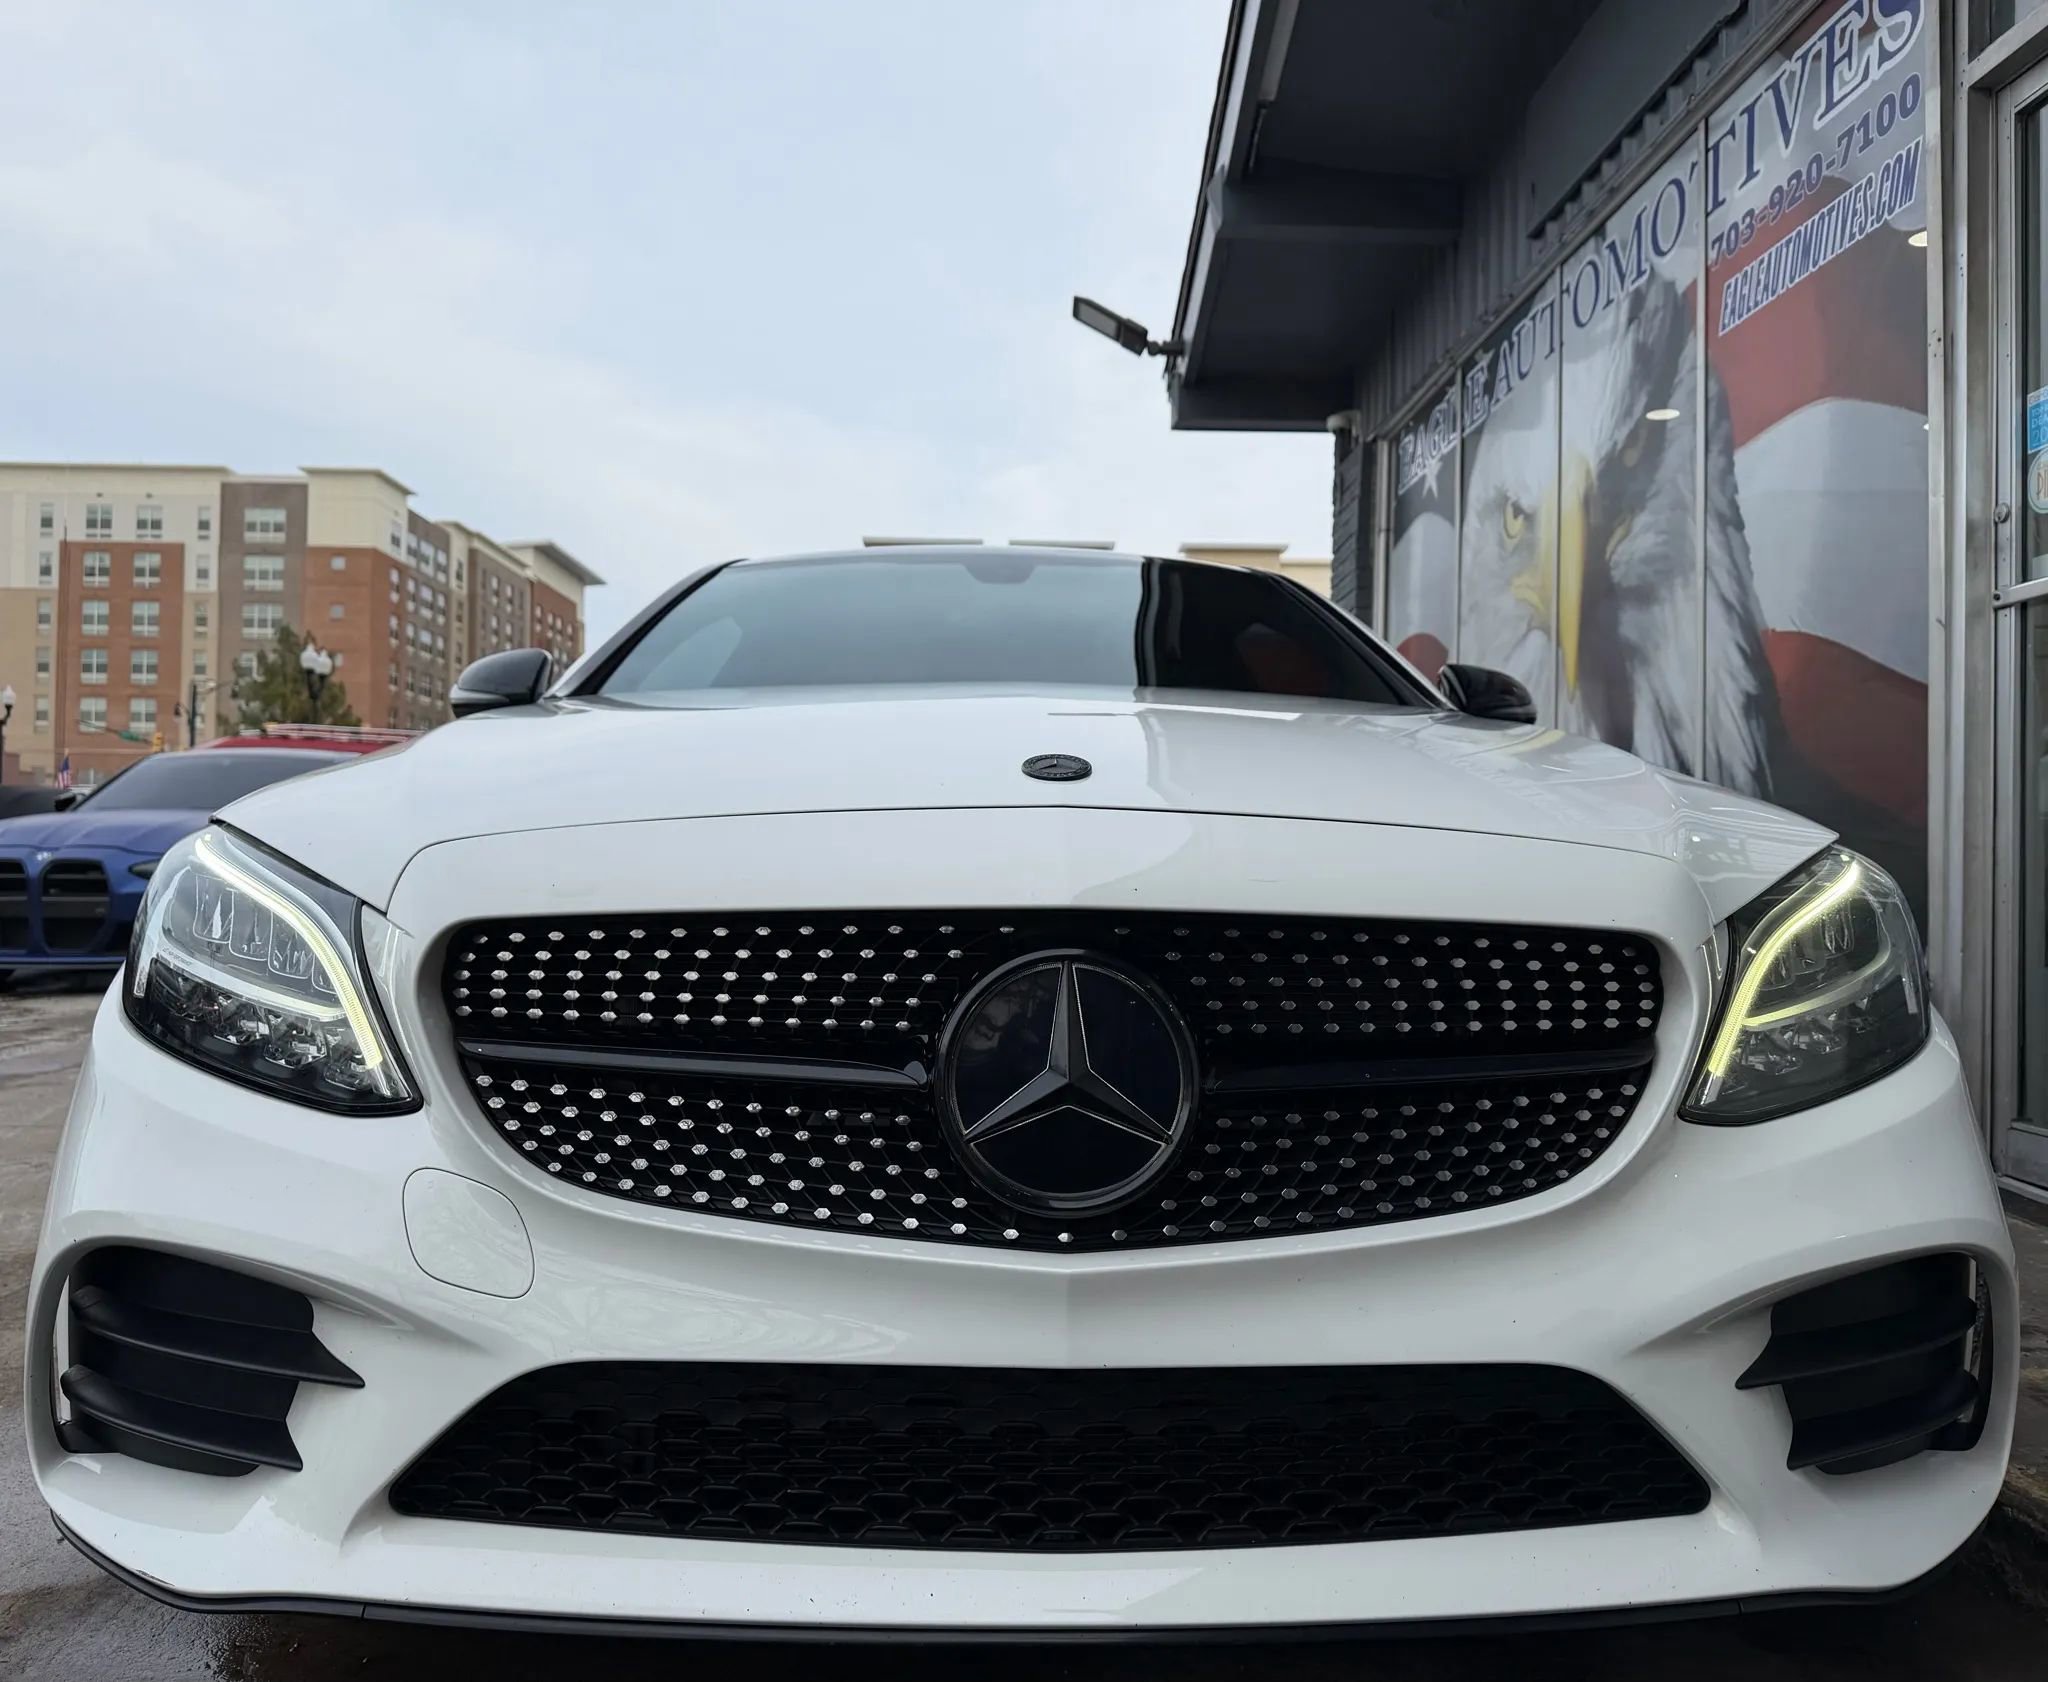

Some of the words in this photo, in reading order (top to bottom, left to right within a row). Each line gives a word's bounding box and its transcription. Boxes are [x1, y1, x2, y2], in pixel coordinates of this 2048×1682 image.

[1399, 360, 1491, 494] EAGLE
[1491, 0, 1925, 412] AUTOMOTIVES
[1711, 72, 1922, 271] 703-920-7100
[1719, 136, 1924, 336] EAGLEAUTOMOTIVES.COM
